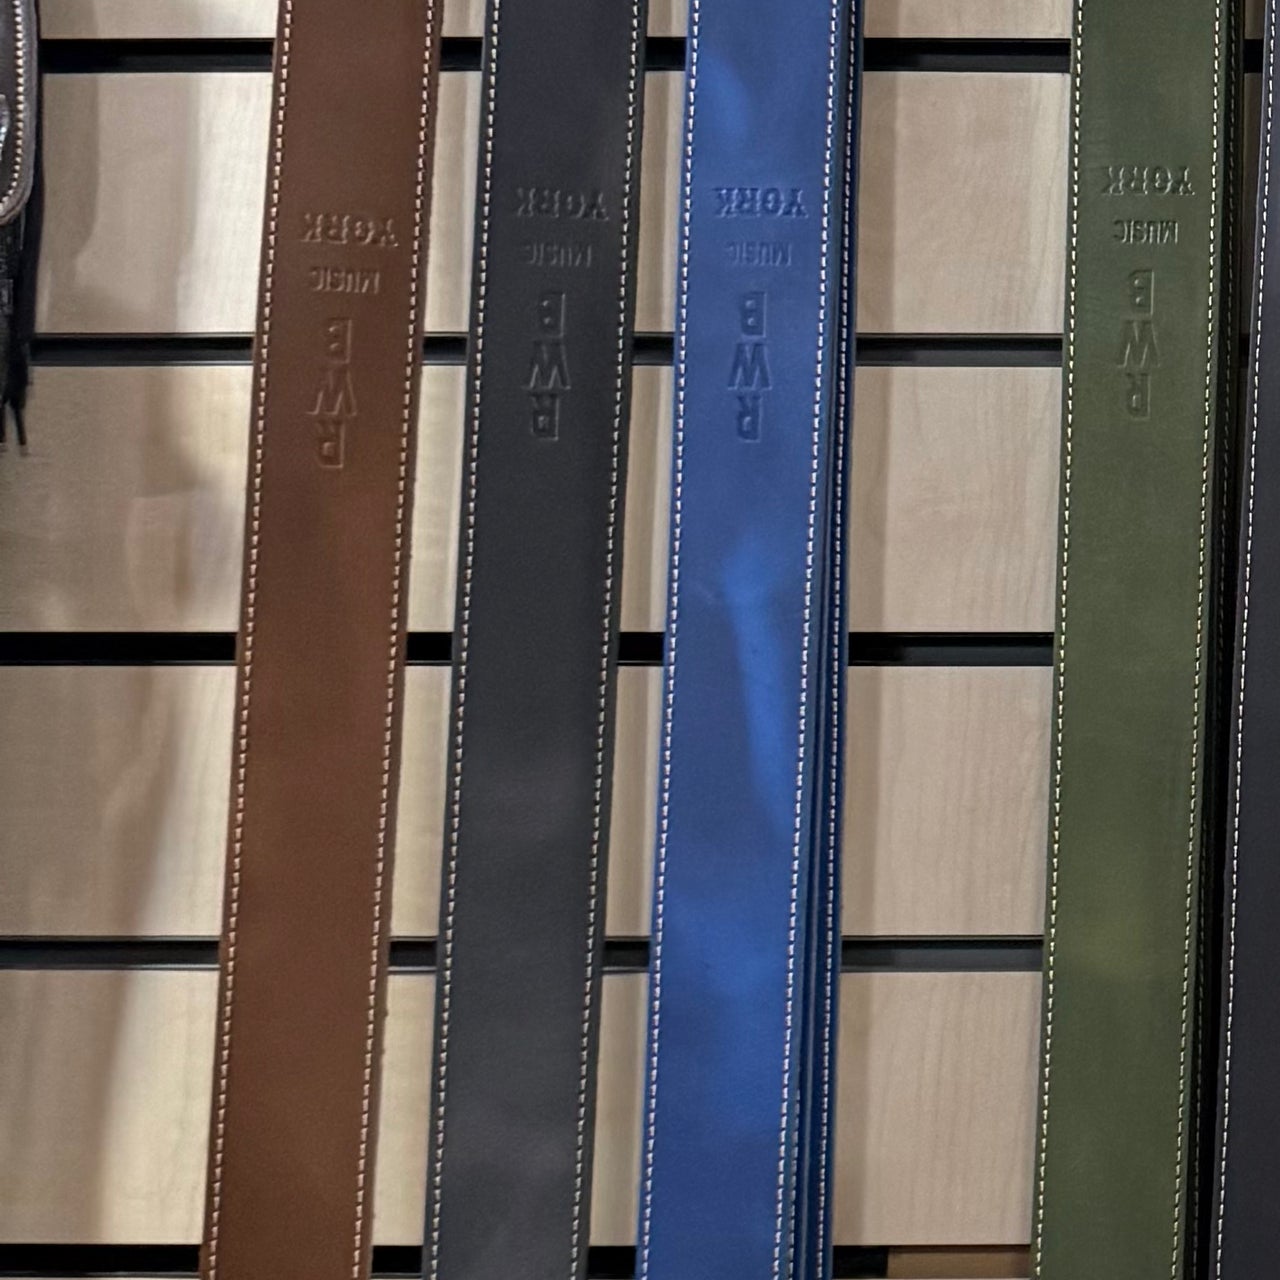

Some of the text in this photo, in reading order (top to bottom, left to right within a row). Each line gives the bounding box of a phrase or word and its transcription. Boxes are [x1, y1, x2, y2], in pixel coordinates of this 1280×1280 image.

[1101, 166, 1195, 196] YORK
[514, 187, 609, 220] YORK
[712, 187, 809, 218] YORK
[300, 213, 399, 247] YORK
[1114, 220, 1179, 244] MUSIC
[525, 244, 592, 267] MUSIC
[726, 241, 792, 267] MUSIC
[310, 267, 380, 294] MUSIC
